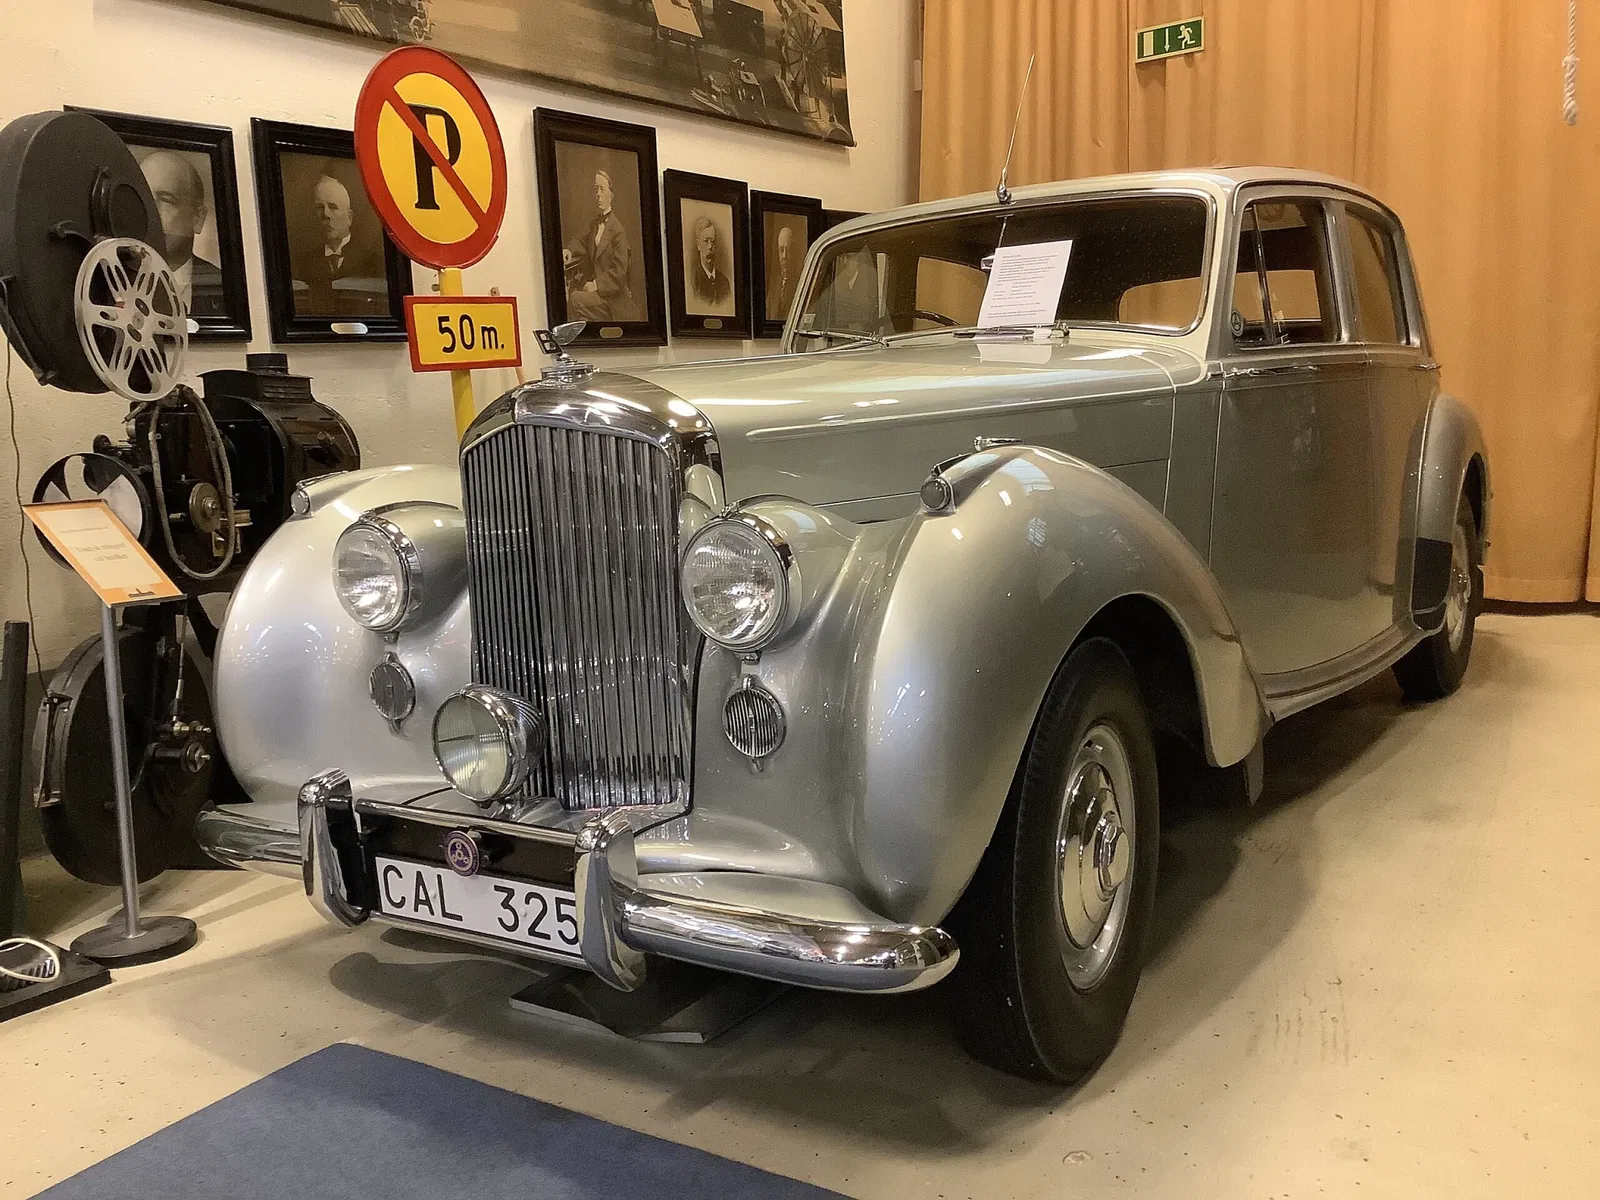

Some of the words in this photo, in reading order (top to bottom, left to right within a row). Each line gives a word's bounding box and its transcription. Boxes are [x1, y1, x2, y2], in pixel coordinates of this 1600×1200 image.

[407, 102, 462, 210] P
[437, 313, 476, 354] 50
[481, 325, 506, 350] m.
[383, 864, 463, 922] CAL
[493, 884, 579, 945] 325
